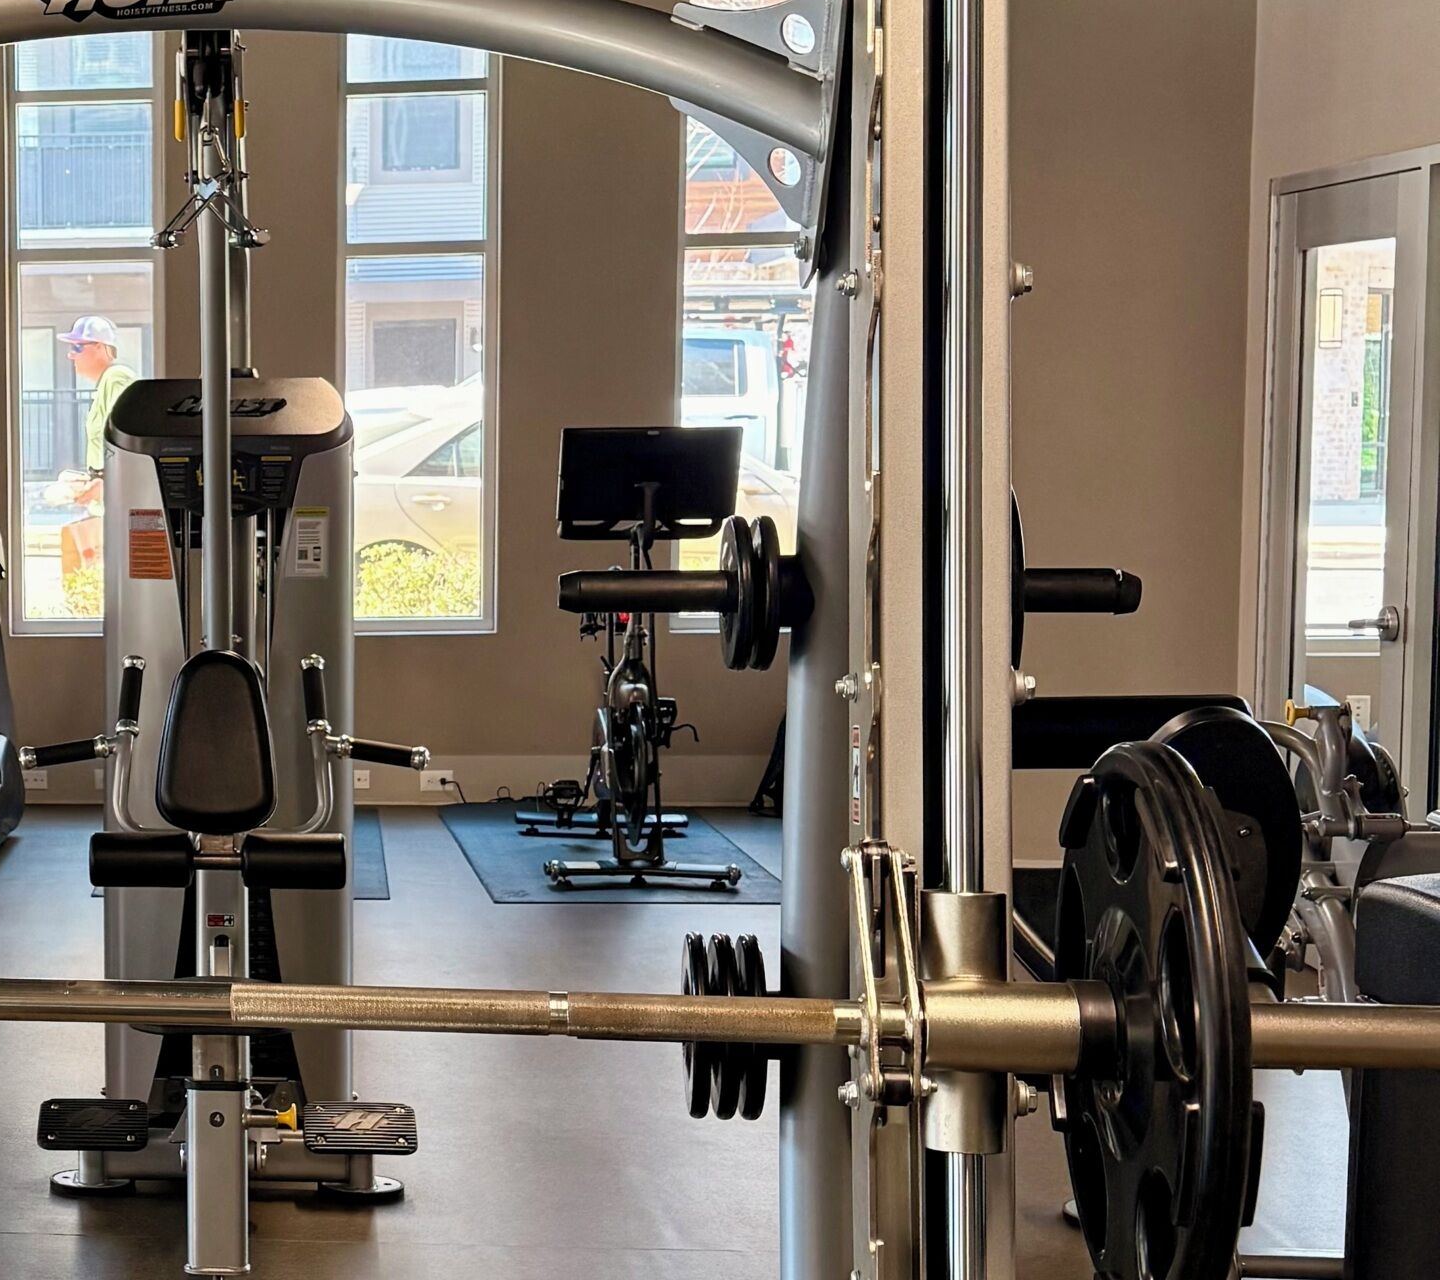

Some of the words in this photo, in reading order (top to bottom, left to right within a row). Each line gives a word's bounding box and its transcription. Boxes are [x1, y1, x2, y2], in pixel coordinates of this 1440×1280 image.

[116, 2, 214, 17] HOISTFITNESS.COM
[175, 398, 276, 414] HIST
[213, 1067, 220, 1078] 1
[213, 1113, 221, 1124] 4
